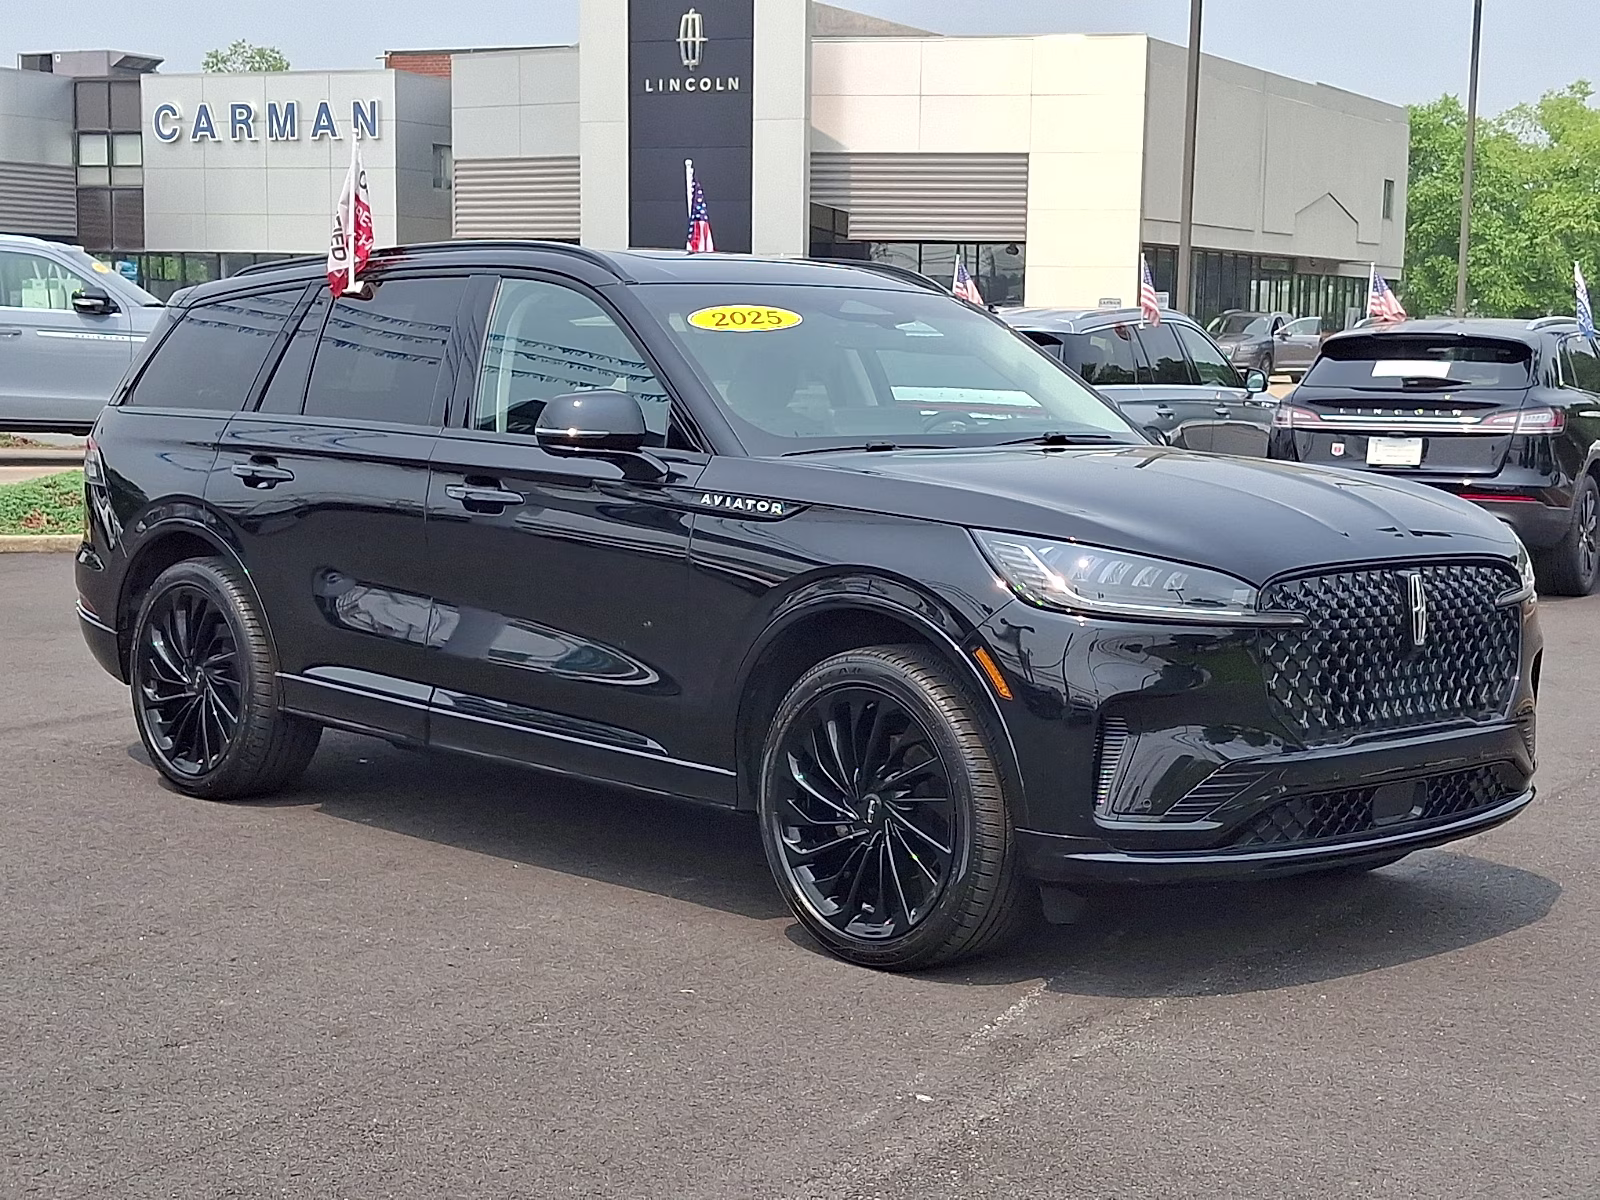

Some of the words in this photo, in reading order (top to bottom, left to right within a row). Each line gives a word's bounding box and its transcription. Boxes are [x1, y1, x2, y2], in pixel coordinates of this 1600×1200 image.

[645, 77, 740, 92] LINCOLN
[152, 99, 380, 142] CARMAN
[711, 311, 782, 327] 2025
[1339, 407, 1462, 416] LINCOLN
[700, 493, 784, 515] AVIATOR
